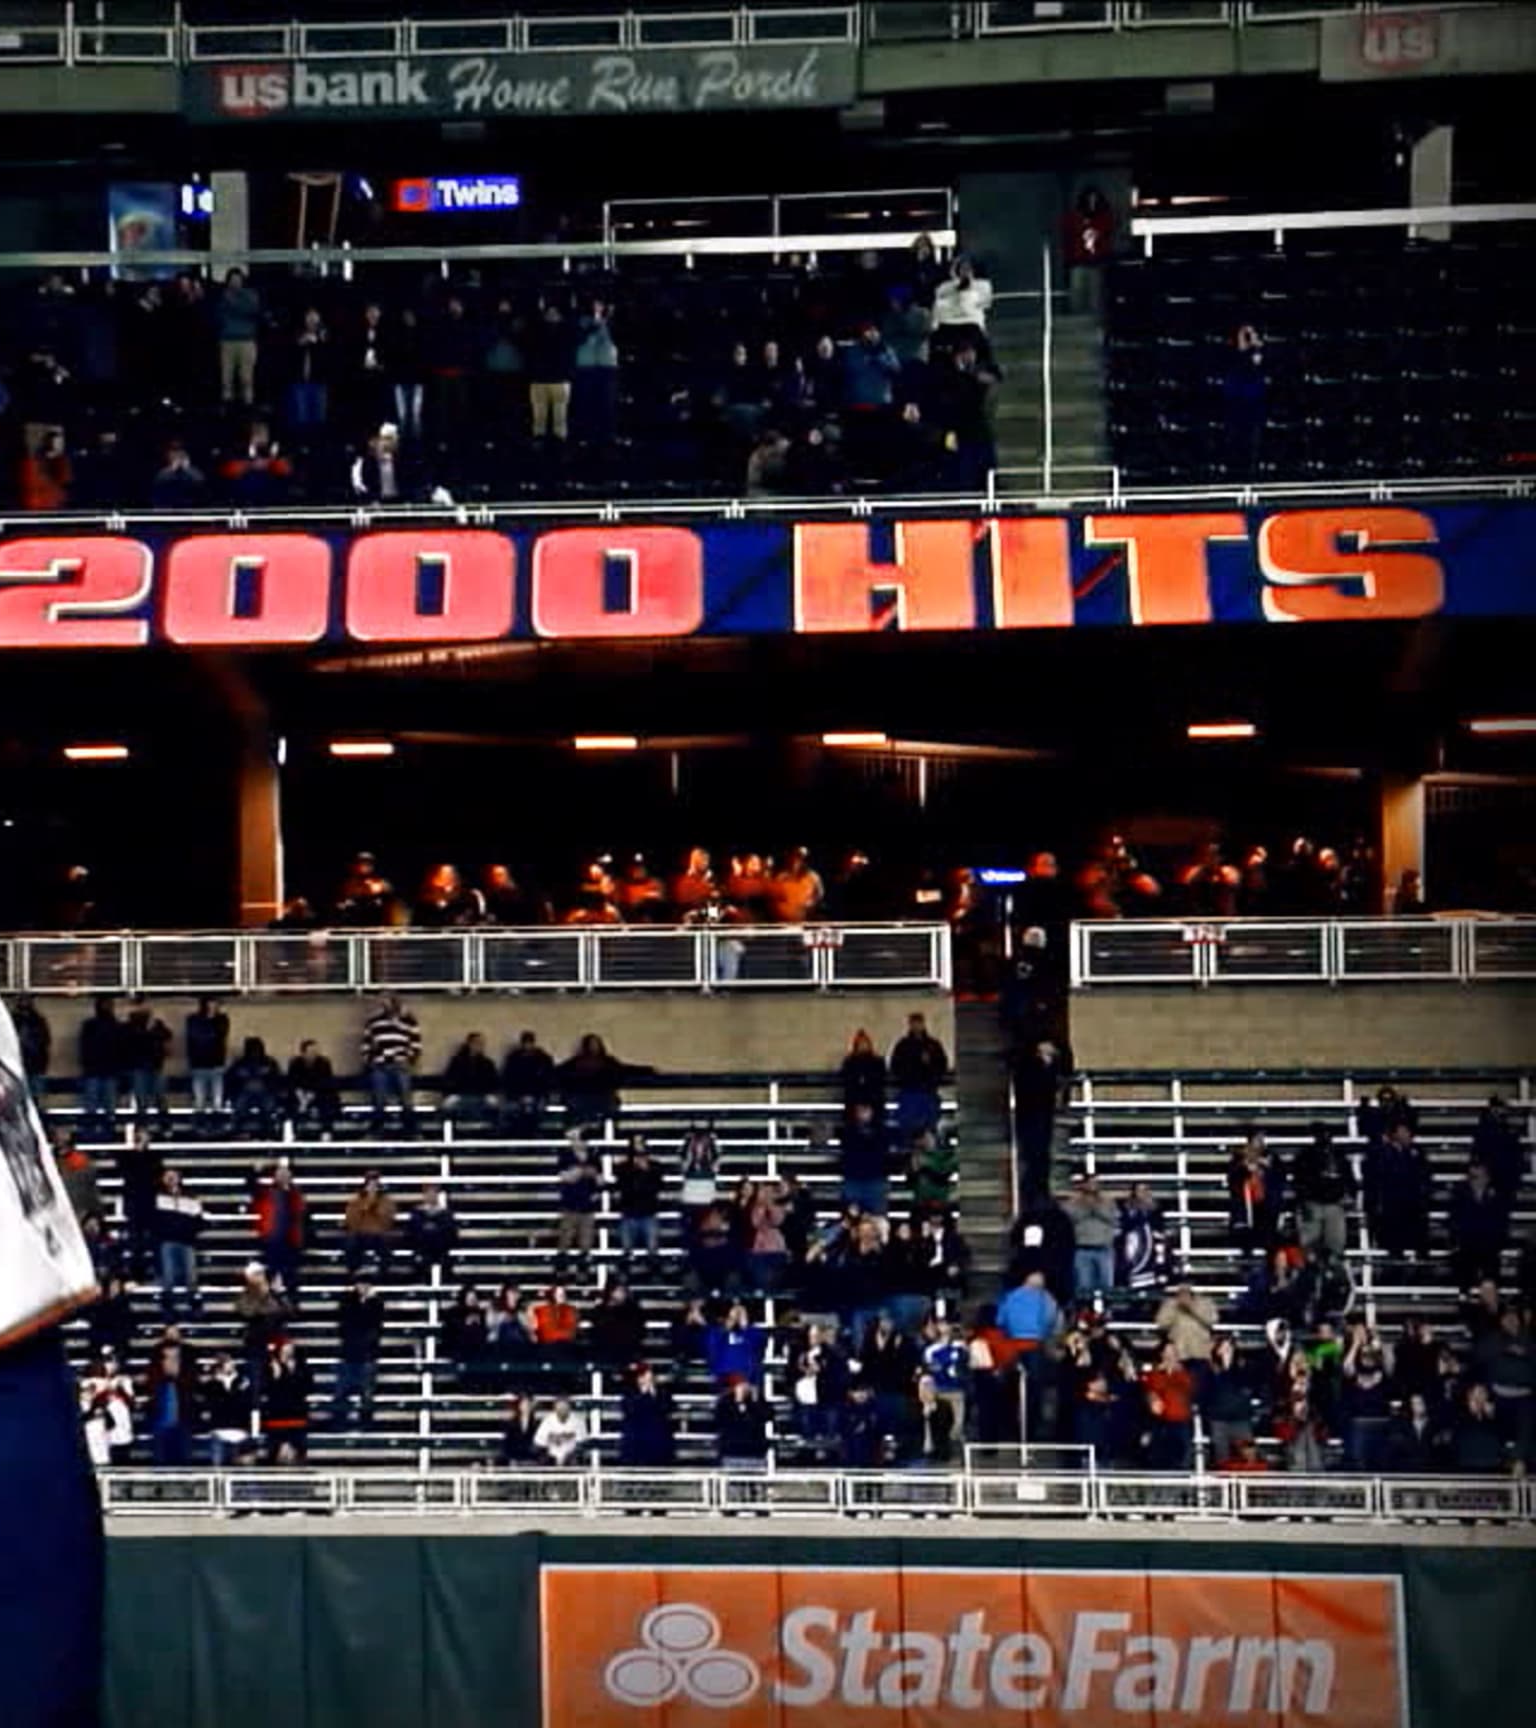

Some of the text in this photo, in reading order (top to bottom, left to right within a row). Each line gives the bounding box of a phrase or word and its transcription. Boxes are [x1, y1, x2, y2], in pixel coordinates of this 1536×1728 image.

[449, 57, 569, 112] Home
[589, 56, 681, 111] Run
[692, 47, 820, 109] Porch
[436, 178, 519, 207] Twins
[792, 508, 1446, 633] HITS
